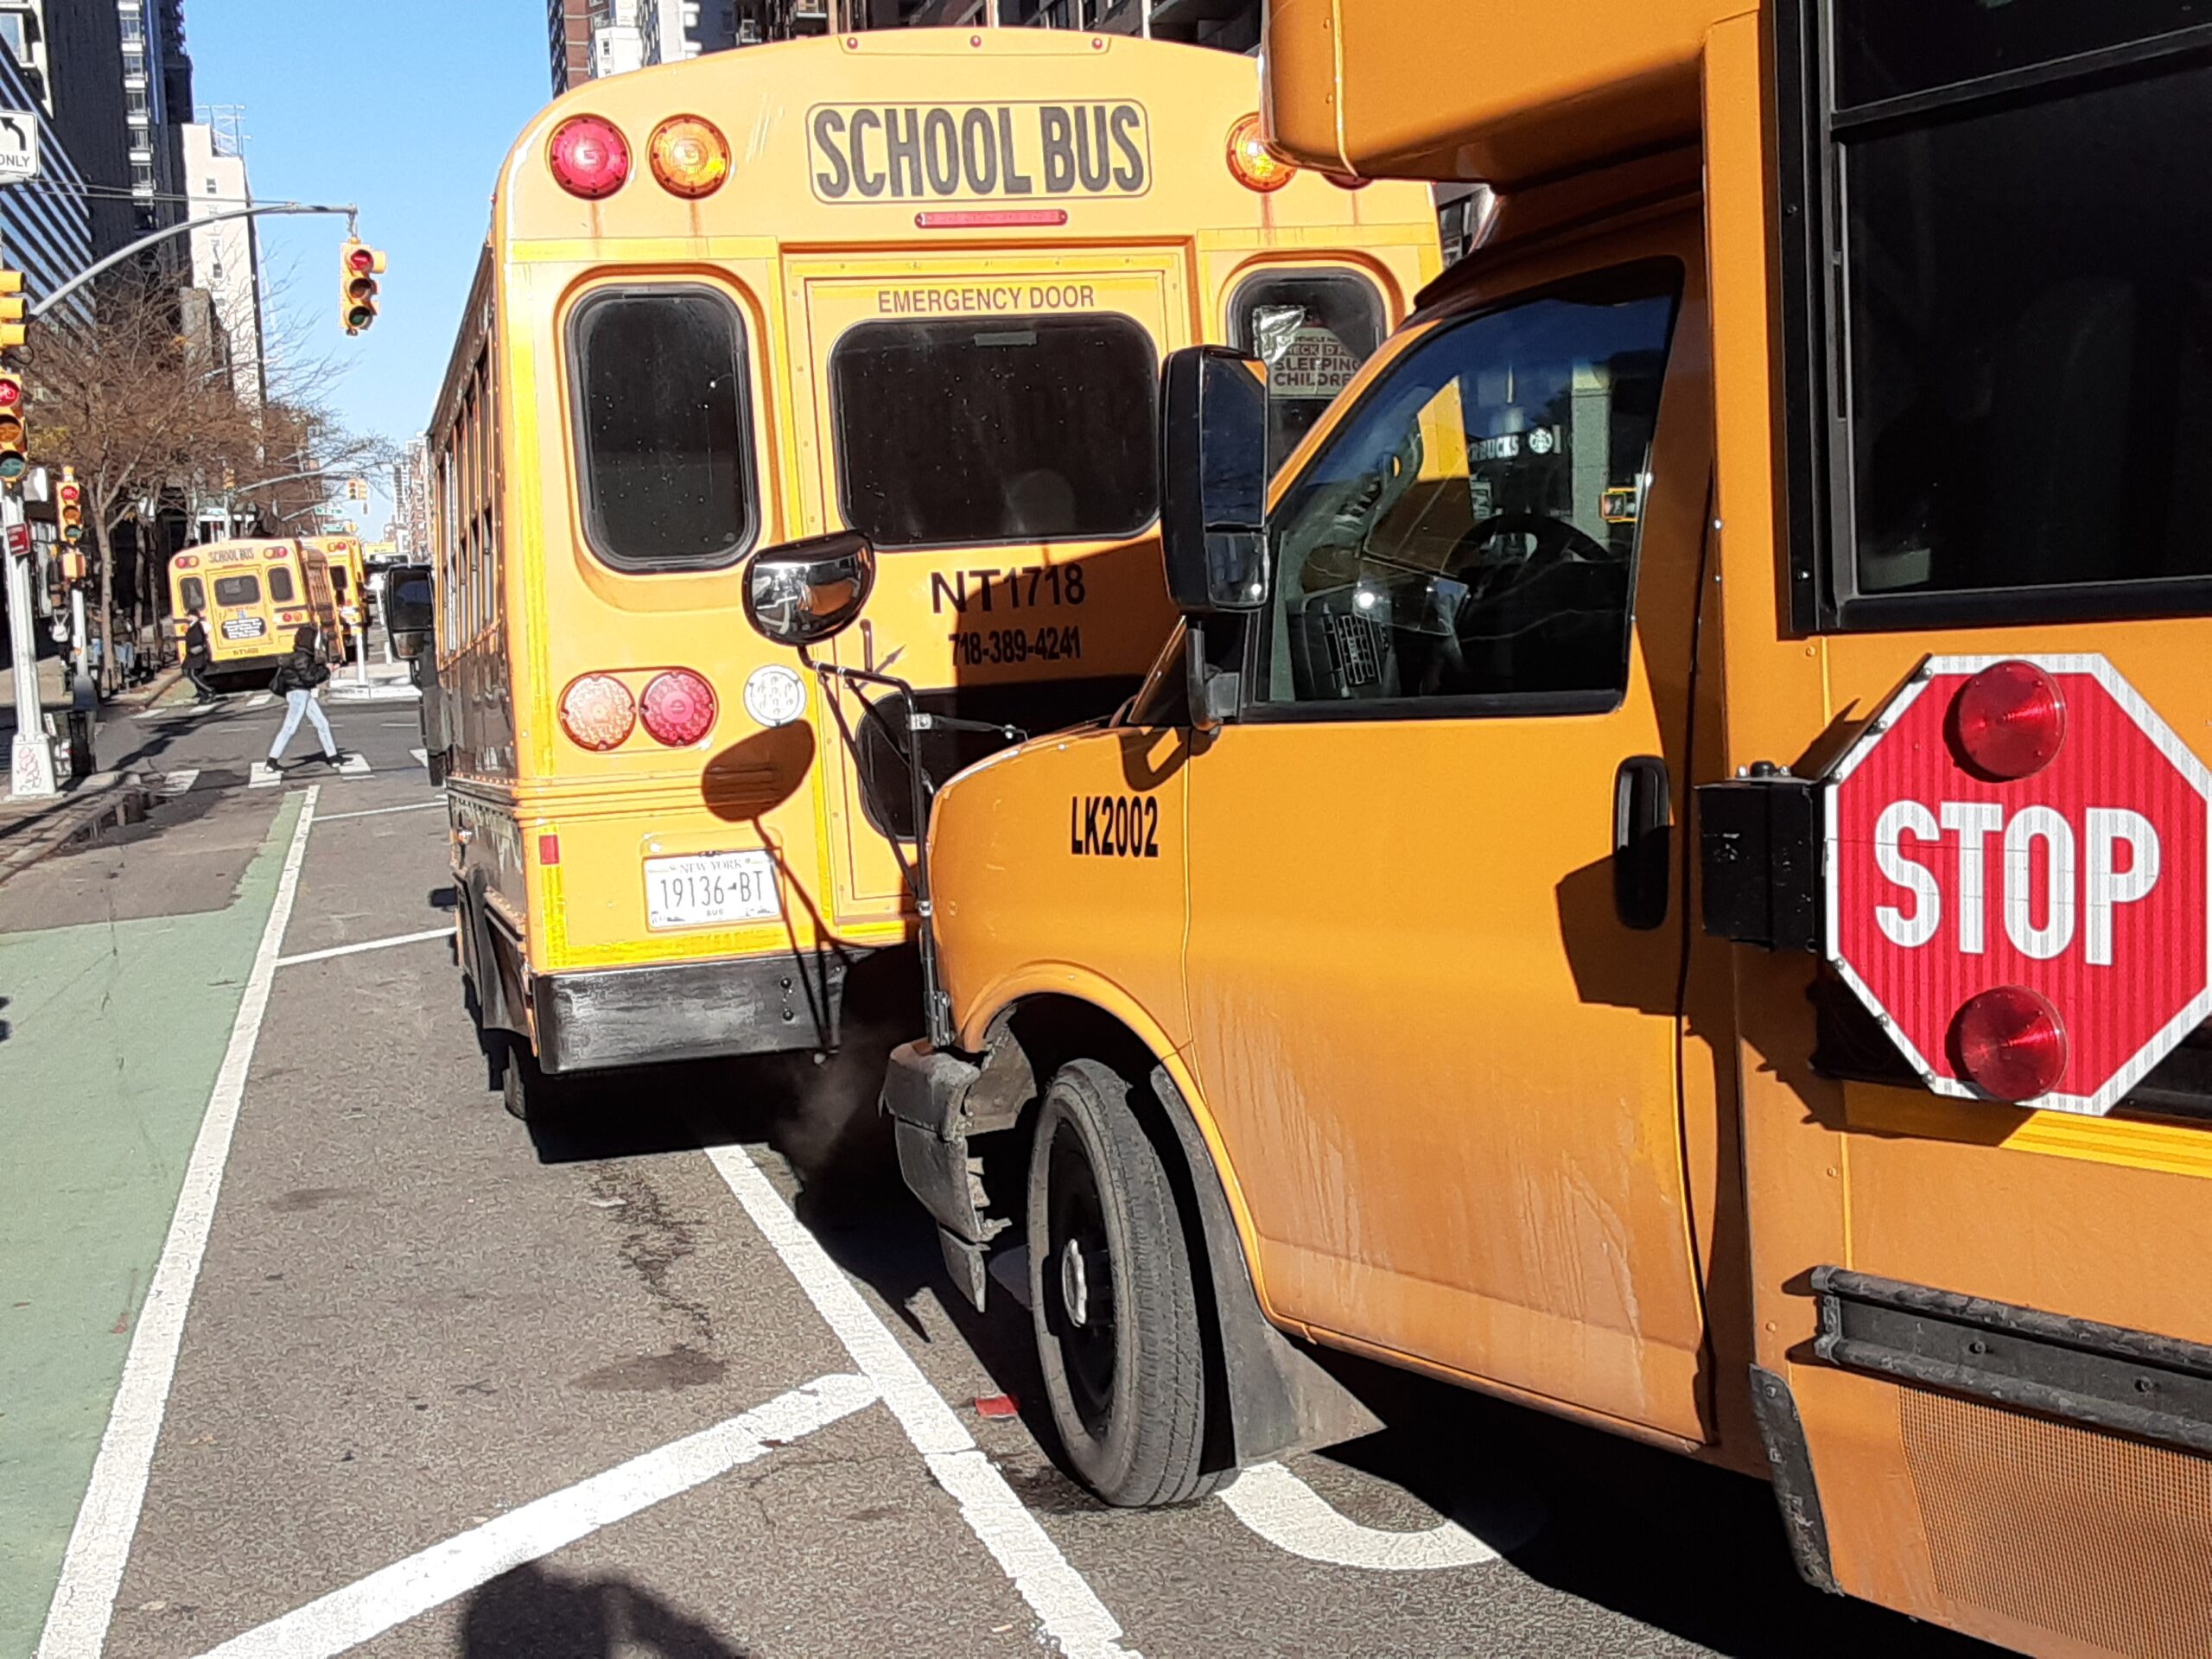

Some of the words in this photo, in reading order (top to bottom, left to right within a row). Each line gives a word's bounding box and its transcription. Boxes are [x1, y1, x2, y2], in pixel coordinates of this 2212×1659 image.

[813, 106, 1033, 199] SCHOOL
[1039, 105, 1145, 194] BUS
[878, 287, 1022, 314] EMERGENCY
[1030, 285, 1095, 309] DOOR
[1274, 372, 1355, 387] CHILDRE
[931, 563, 1086, 614] NT1718
[948, 625, 1082, 667] 718-389-4241
[1071, 796, 1159, 858] LK2002
[680, 862, 706, 874] NEW
[711, 859, 742, 872] YORK
[1874, 799, 2161, 966] STOP
